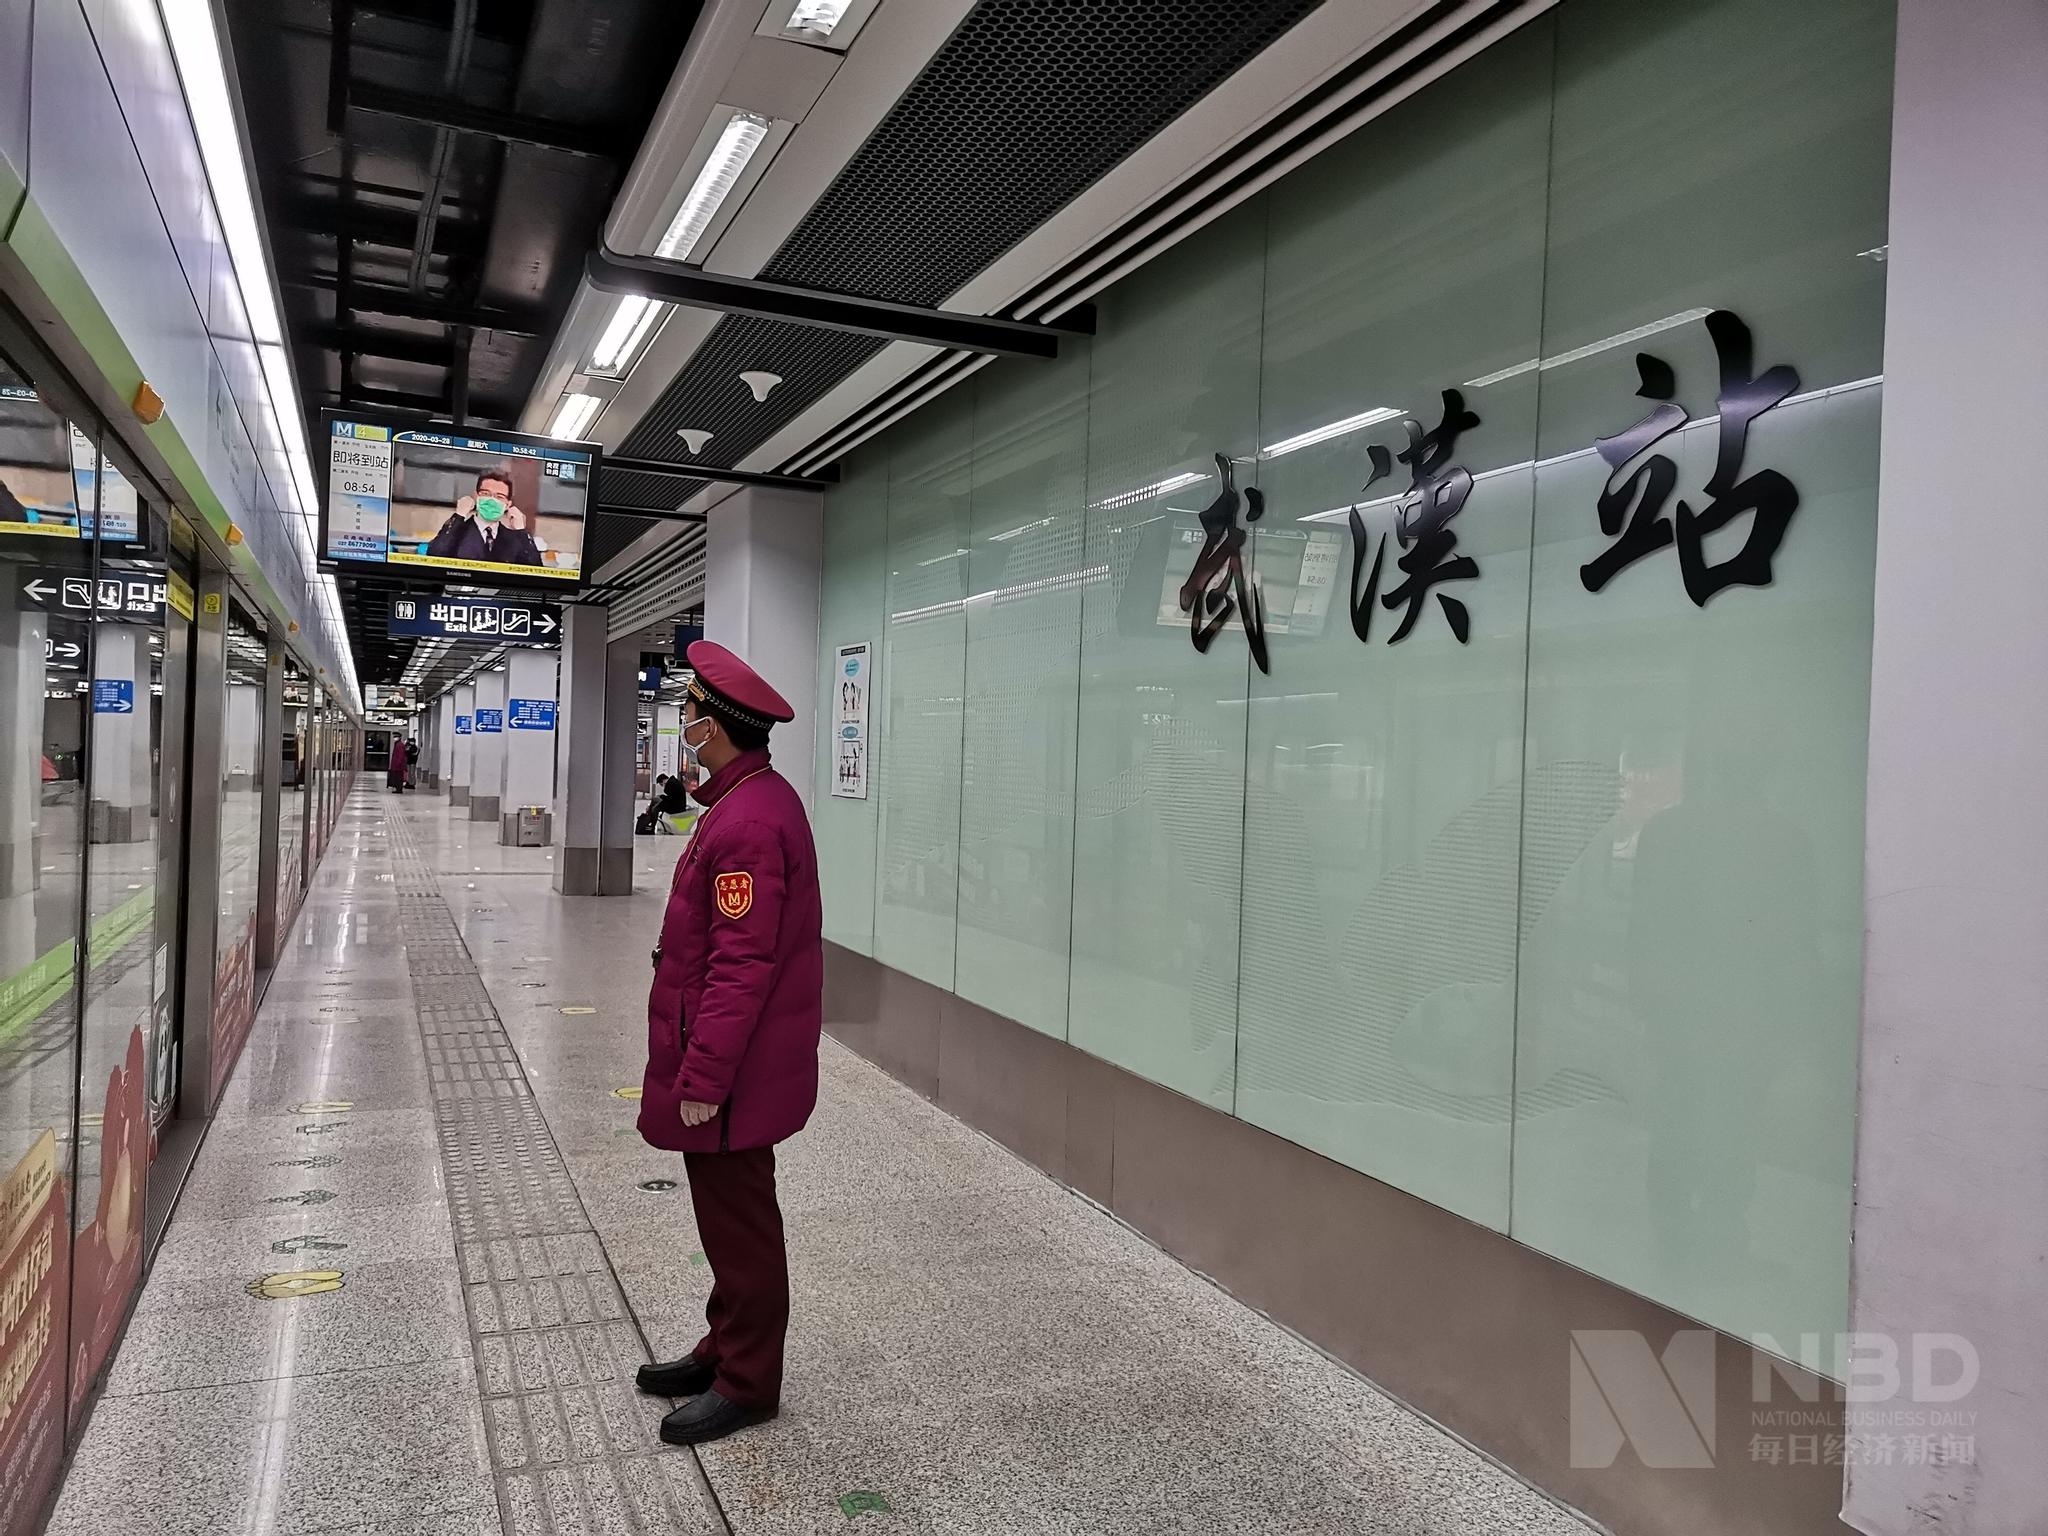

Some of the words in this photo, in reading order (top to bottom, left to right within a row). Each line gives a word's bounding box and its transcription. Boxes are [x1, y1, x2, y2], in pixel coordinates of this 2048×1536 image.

[412, 433, 450, 445] 2020-03-28
[467, 440, 489, 450] 星期六
[333, 450, 389, 469] 即将到站
[344, 481, 375, 493] 08:54
[1180, 309, 1800, 674] 武漢站
[430, 603, 468, 622] 出口
[444, 623, 468, 633] Exit
[720, 877, 749, 891] 志愿者
